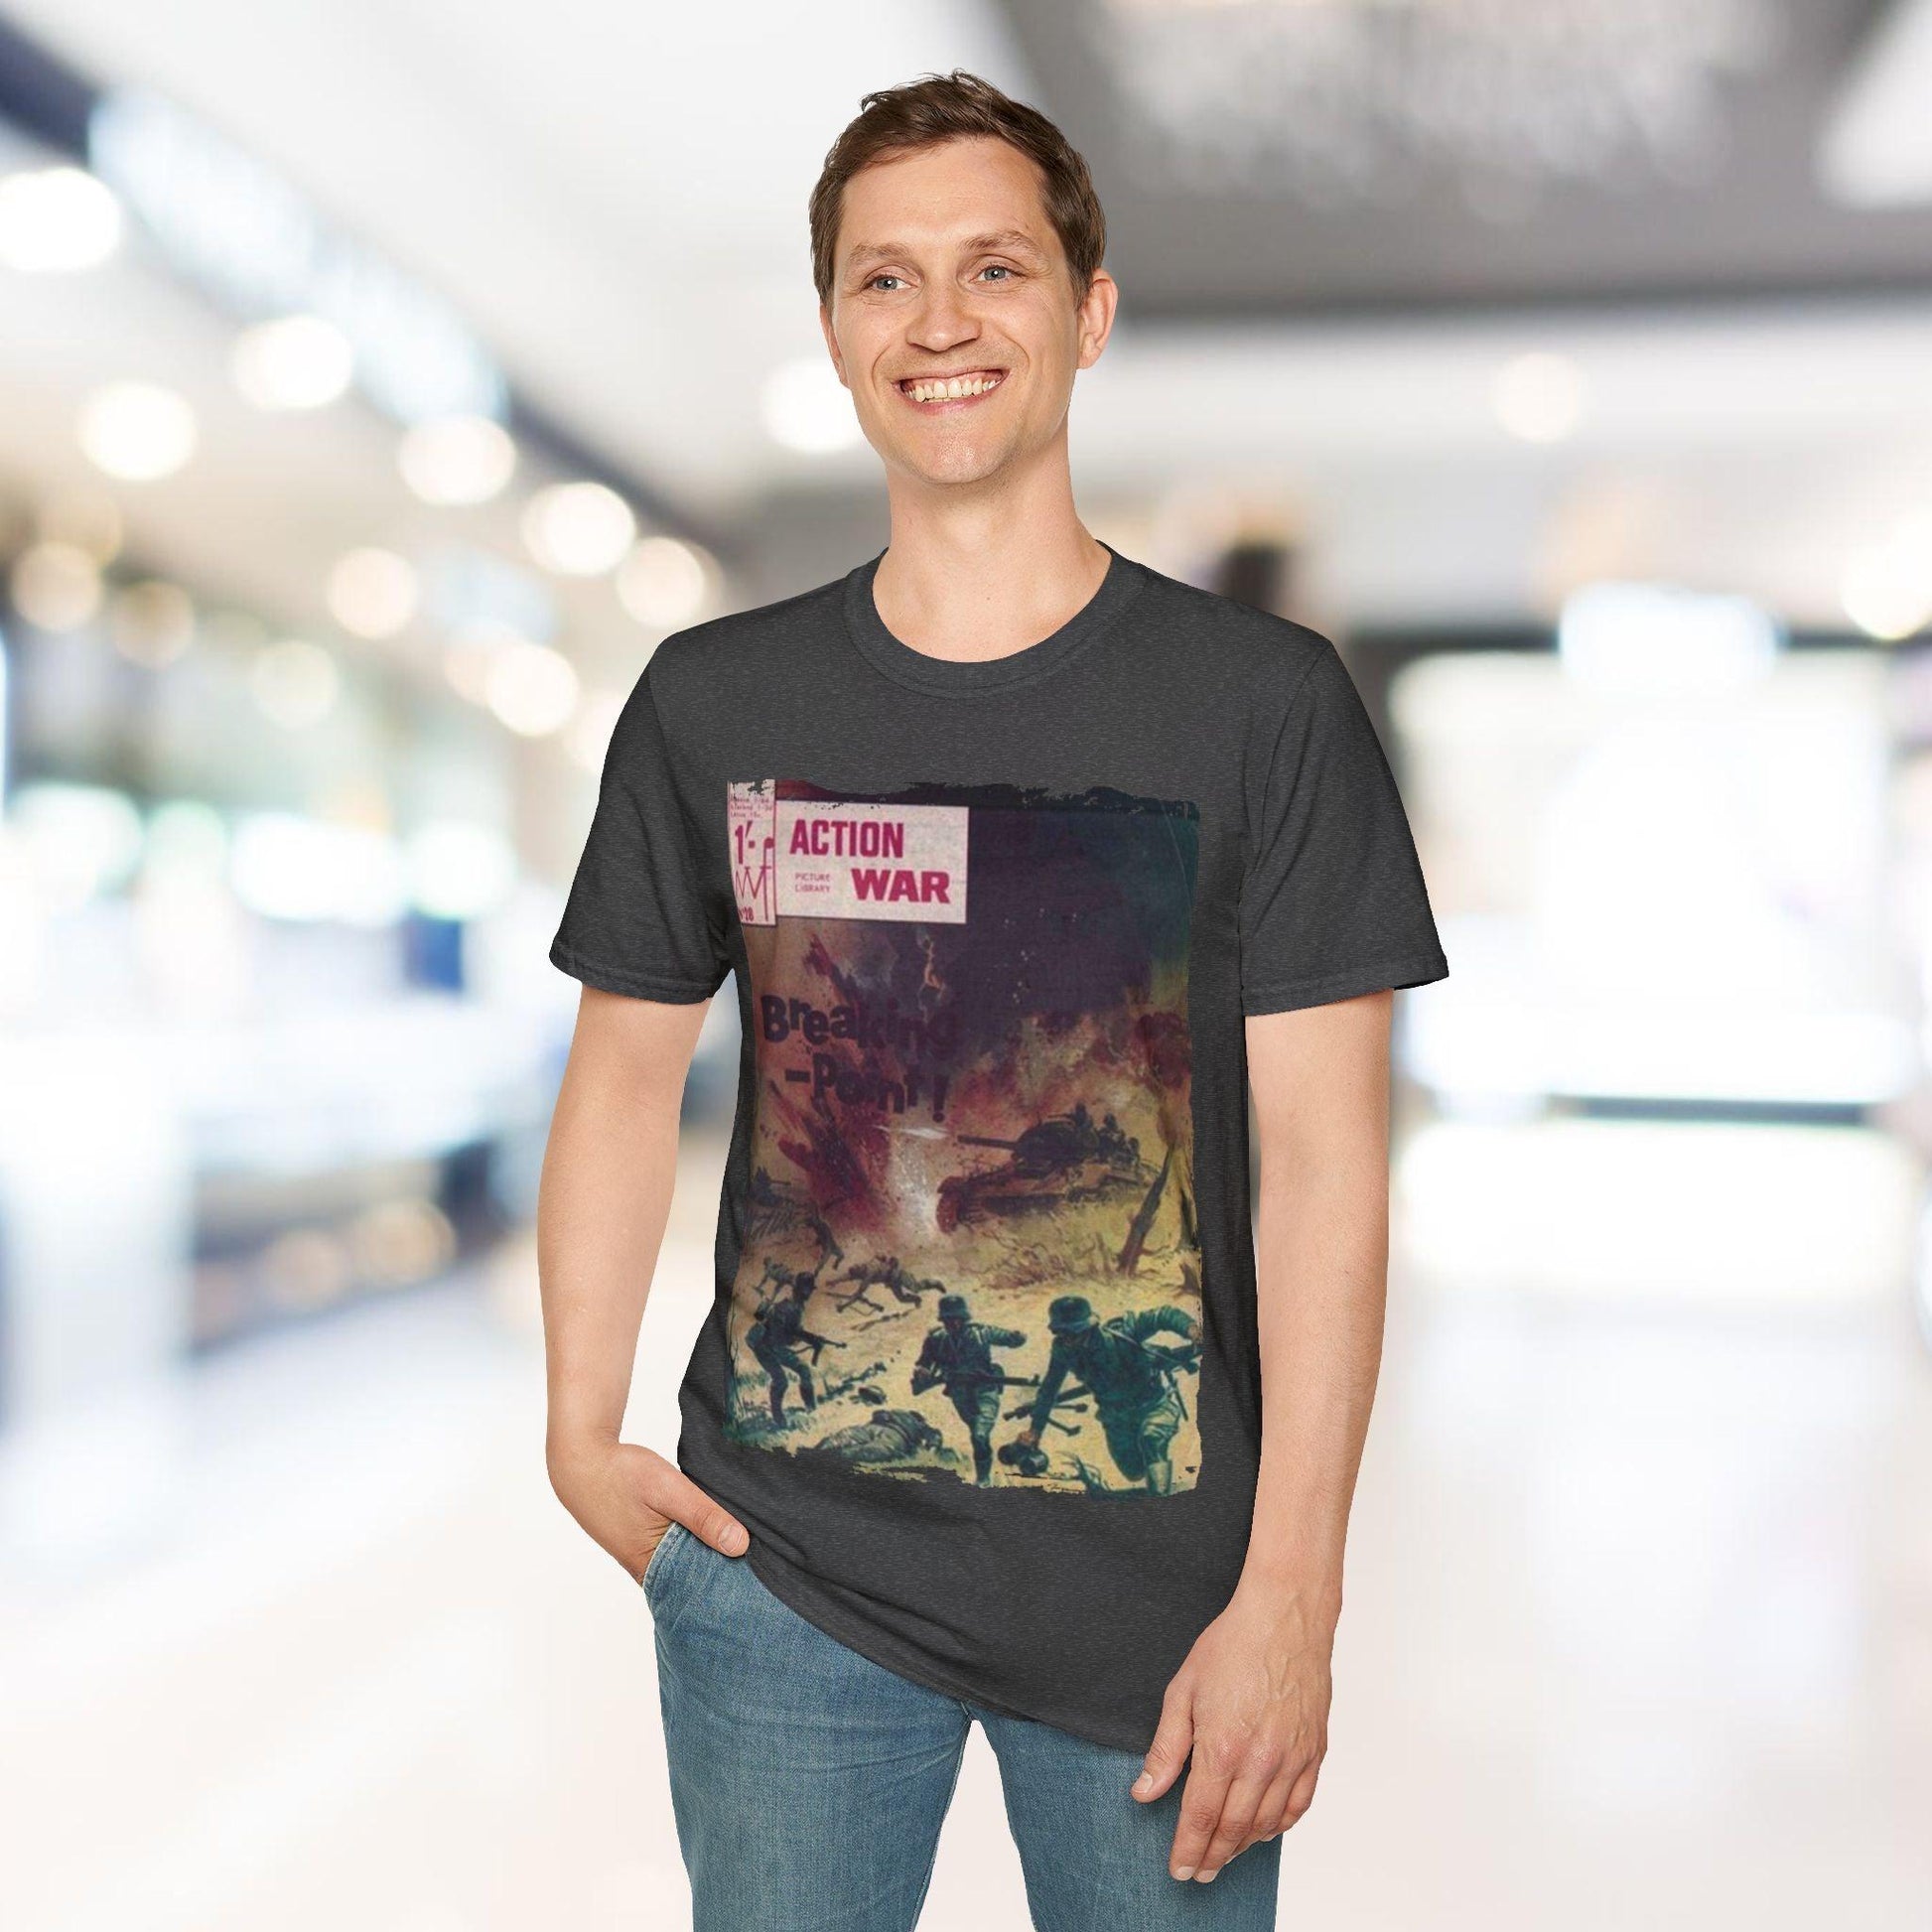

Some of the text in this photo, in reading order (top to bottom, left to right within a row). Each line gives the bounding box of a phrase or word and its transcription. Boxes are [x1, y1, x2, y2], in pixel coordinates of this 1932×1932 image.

[789, 819, 904, 858] ACTION
[795, 872, 831, 882] PICTURE
[795, 884, 831, 893] LIBRARY
[851, 868, 950, 903] WAR
[760, 995, 963, 1062] Breaking
